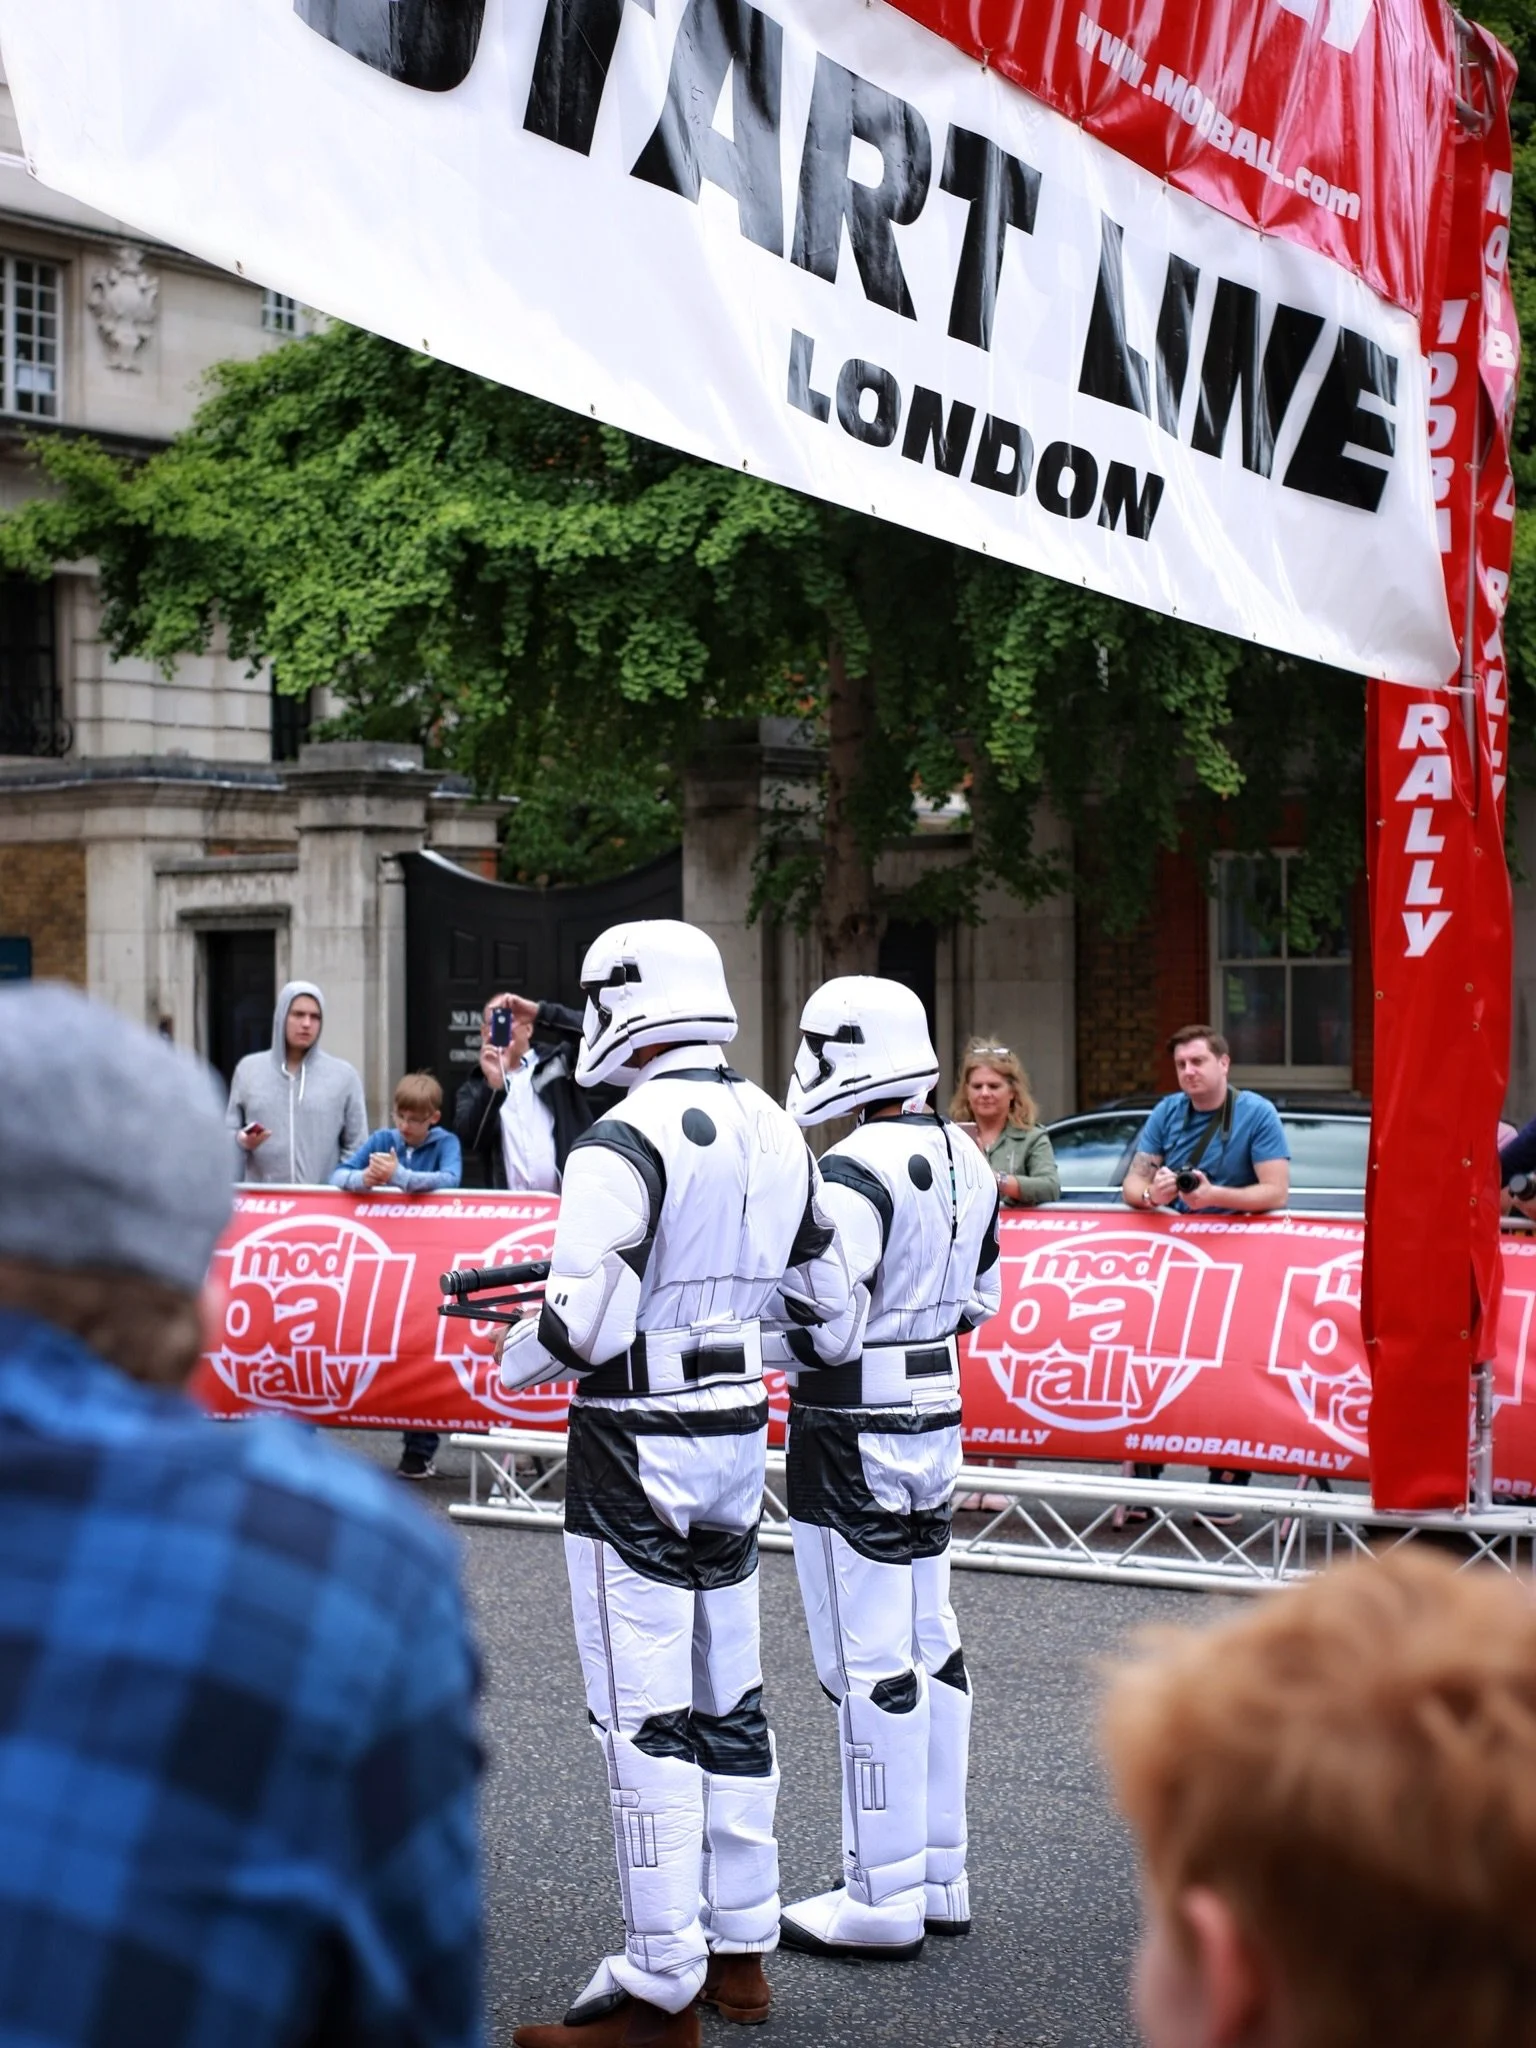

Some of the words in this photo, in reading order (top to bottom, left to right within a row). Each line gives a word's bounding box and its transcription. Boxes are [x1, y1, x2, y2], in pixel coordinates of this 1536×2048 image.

[1077, 208, 1399, 514] LINE
[786, 327, 1166, 542] LONDON
[1394, 702, 1454, 958] RALLY
[354, 1203, 552, 1220] #MODBALLRALLY
[1169, 1222, 1365, 1242] #MODBALLRALL
[233, 1229, 358, 1283] mod
[1026, 1239, 1171, 1286] mod
[231, 1345, 366, 1410] rally
[1006, 1344, 1177, 1425] rally
[1124, 1432, 1353, 1472] #MODBALLRALLY
